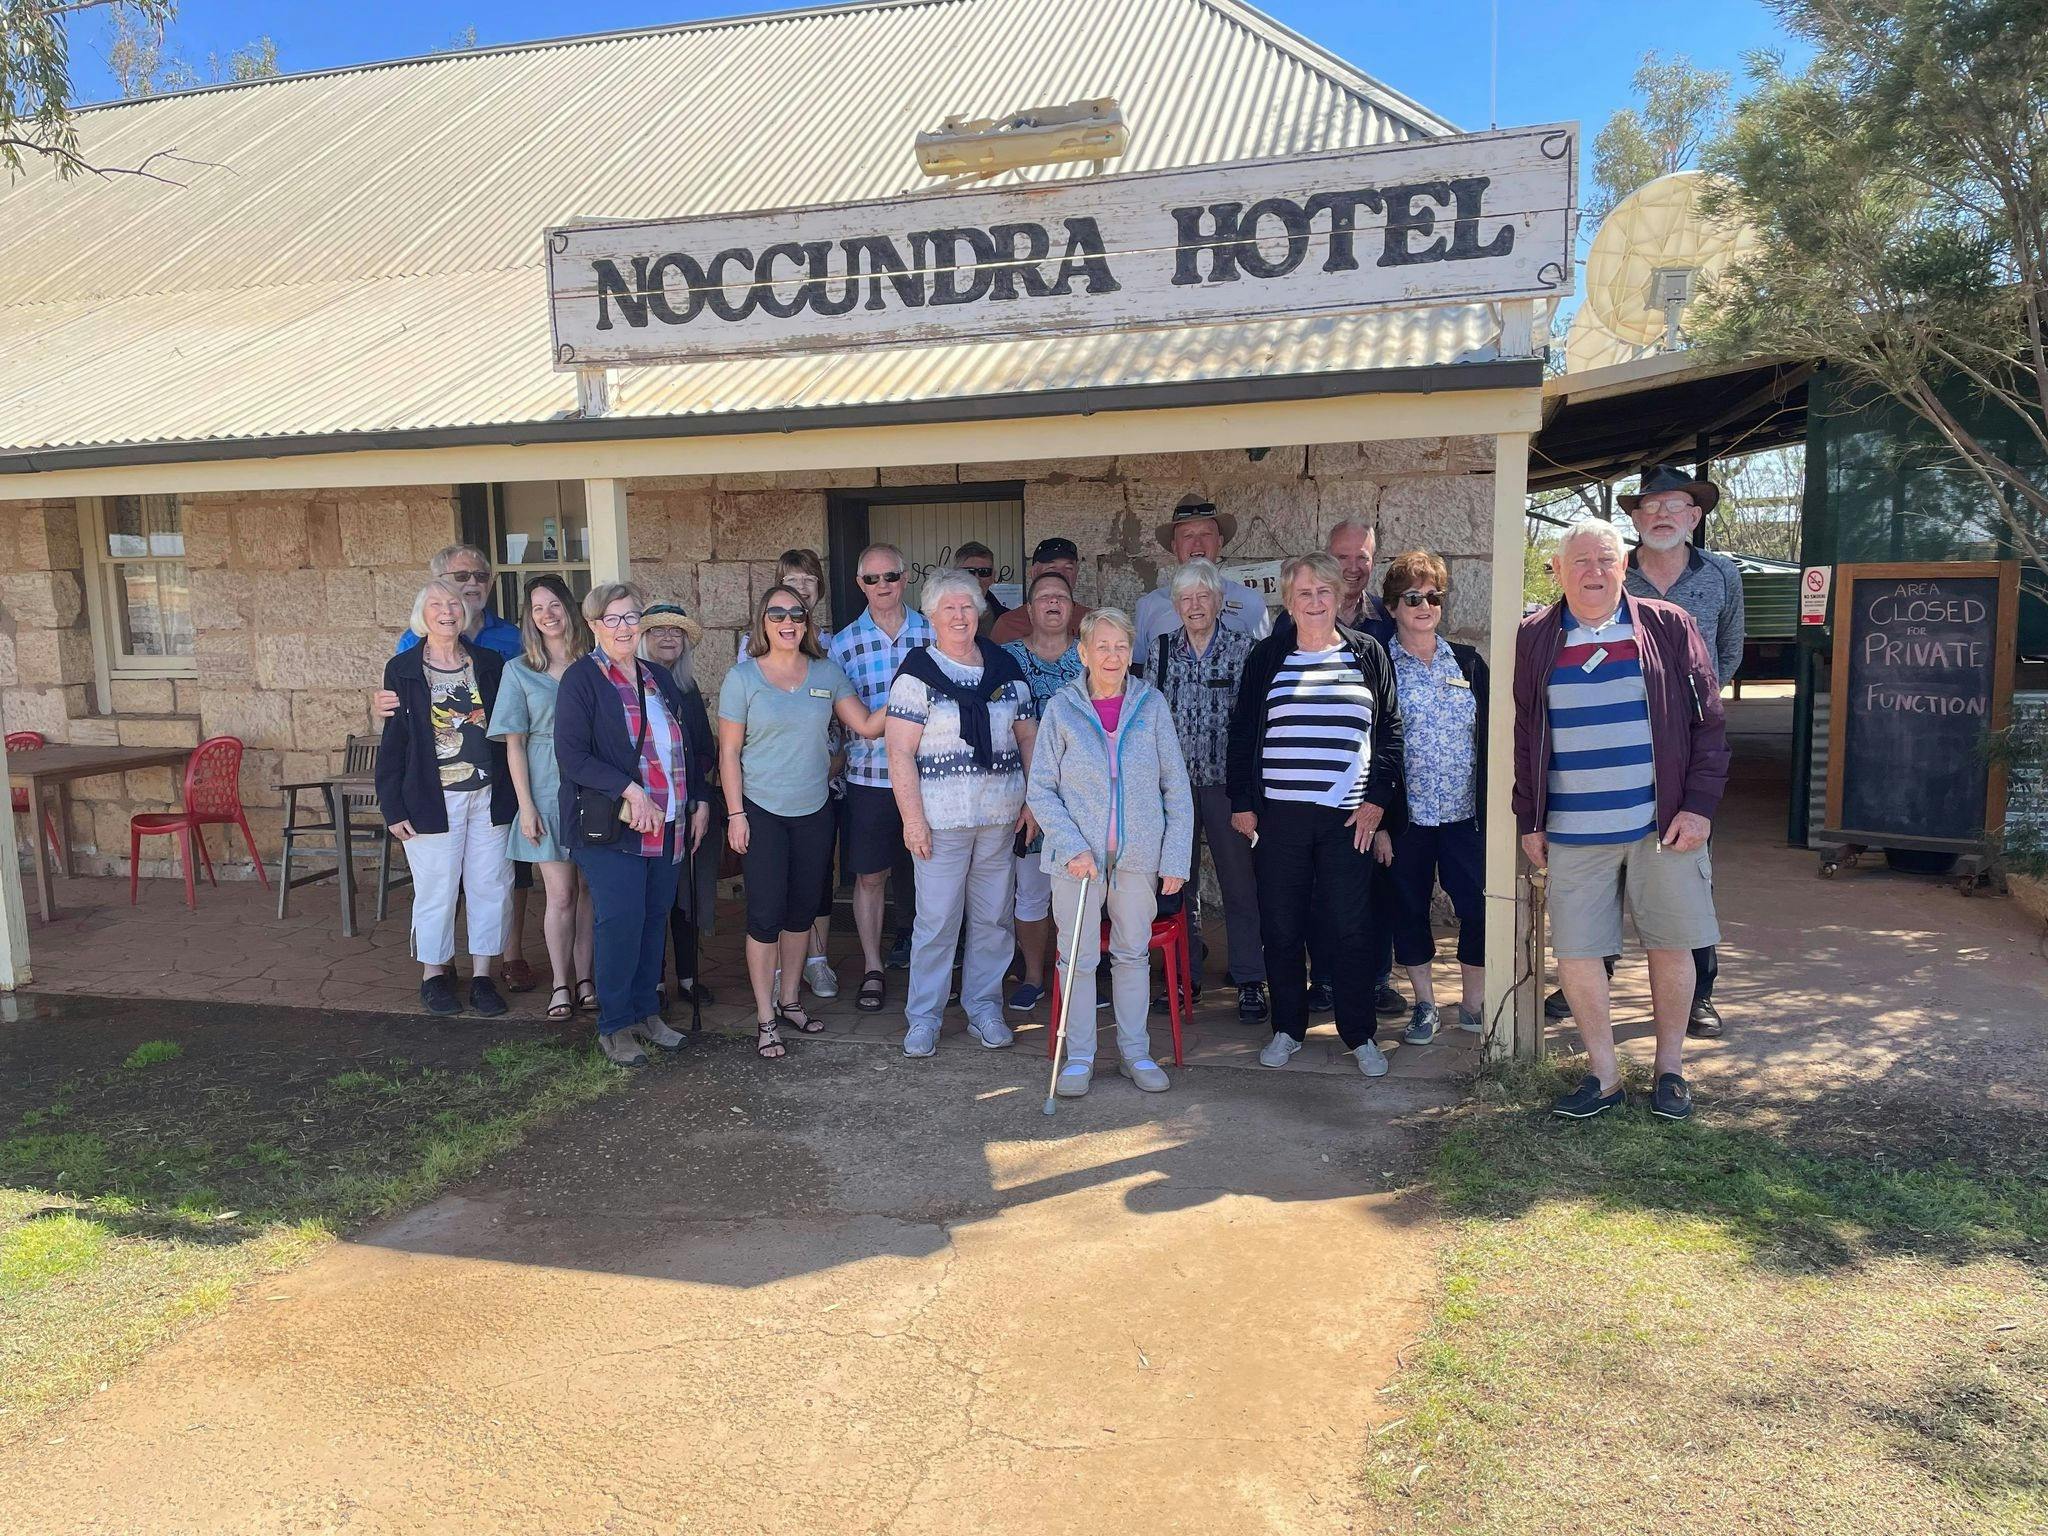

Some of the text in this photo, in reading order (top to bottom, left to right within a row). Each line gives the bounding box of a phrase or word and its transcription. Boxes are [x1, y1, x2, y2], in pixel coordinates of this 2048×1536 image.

[592, 177, 1515, 330] NOCCUNDRA HOTEL
[1894, 583, 1941, 598] AREA
[1869, 596, 1986, 625] CLOSED
[1906, 627, 1928, 636] FOR
[1865, 632, 1984, 668] PRIVATE
[1866, 683, 1987, 716] FUNCTION
